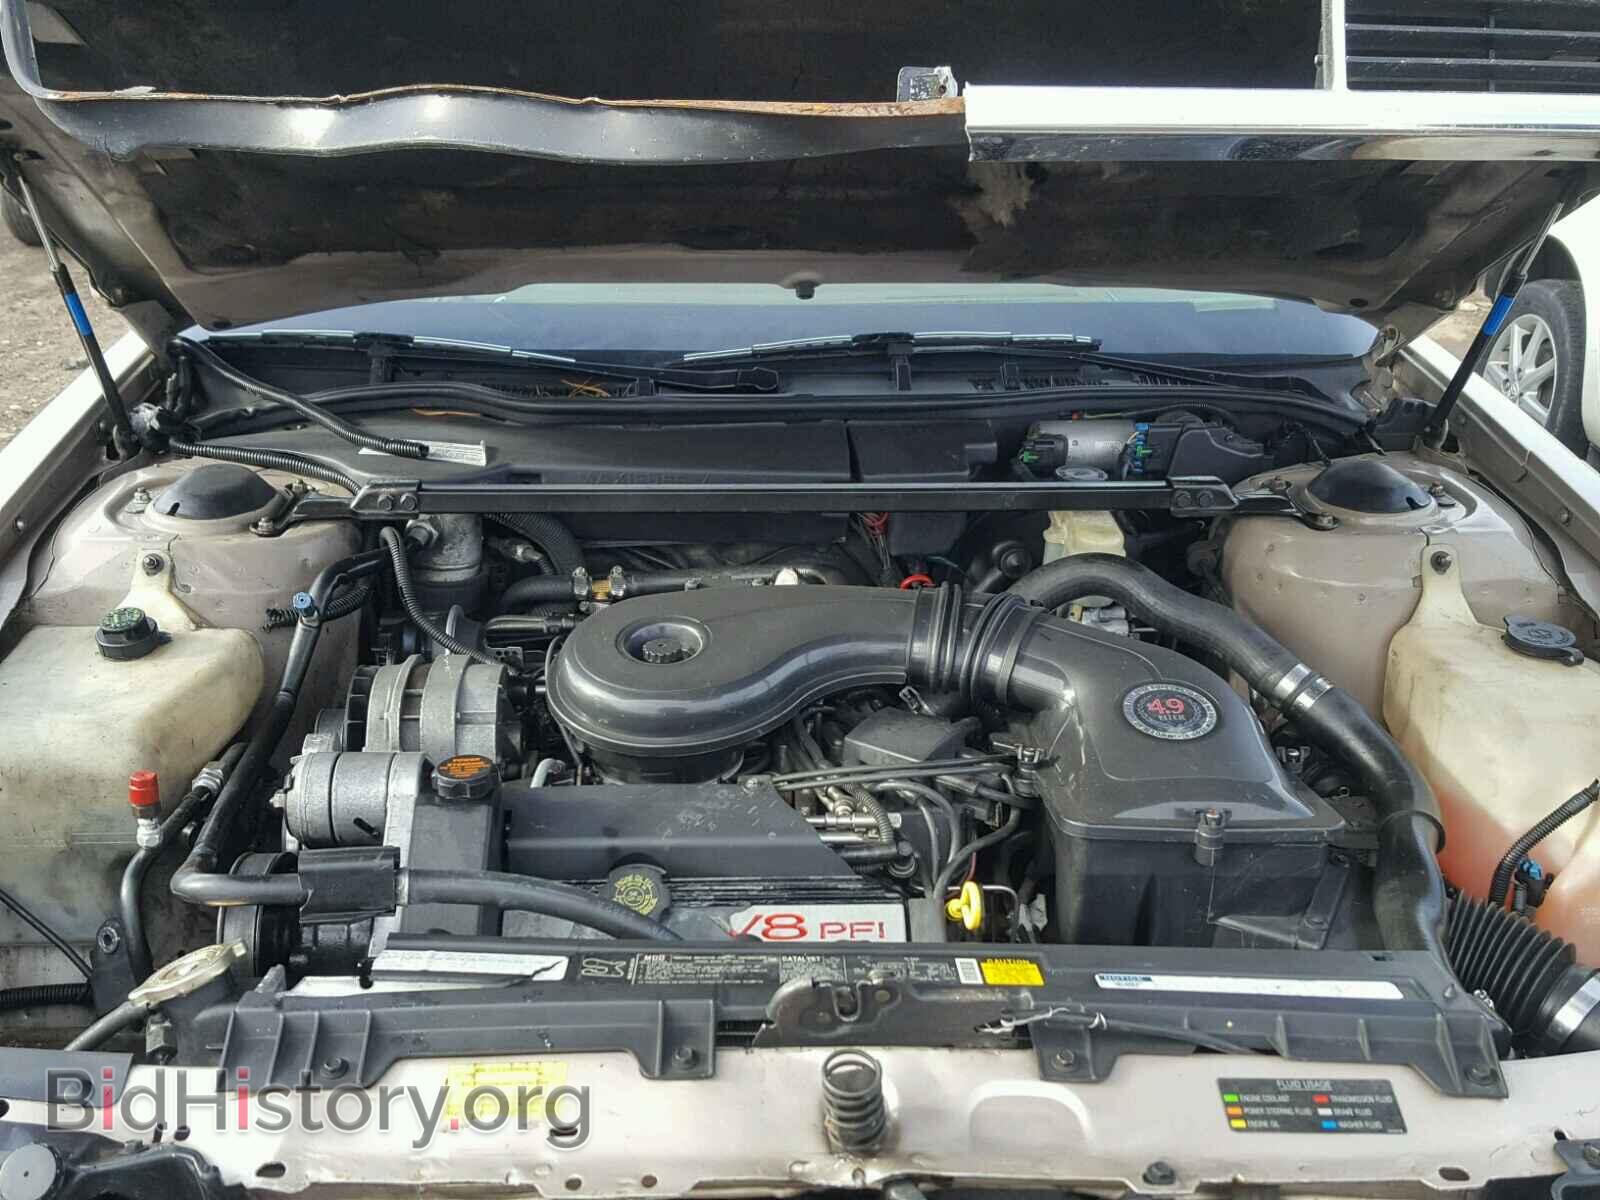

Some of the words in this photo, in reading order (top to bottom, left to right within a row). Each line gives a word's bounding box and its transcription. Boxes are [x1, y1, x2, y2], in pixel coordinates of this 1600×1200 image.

[820, 921, 885, 940] PFI
[1276, 1079, 1301, 1089] FLUID
[1303, 1080, 1333, 1090] USAGE
